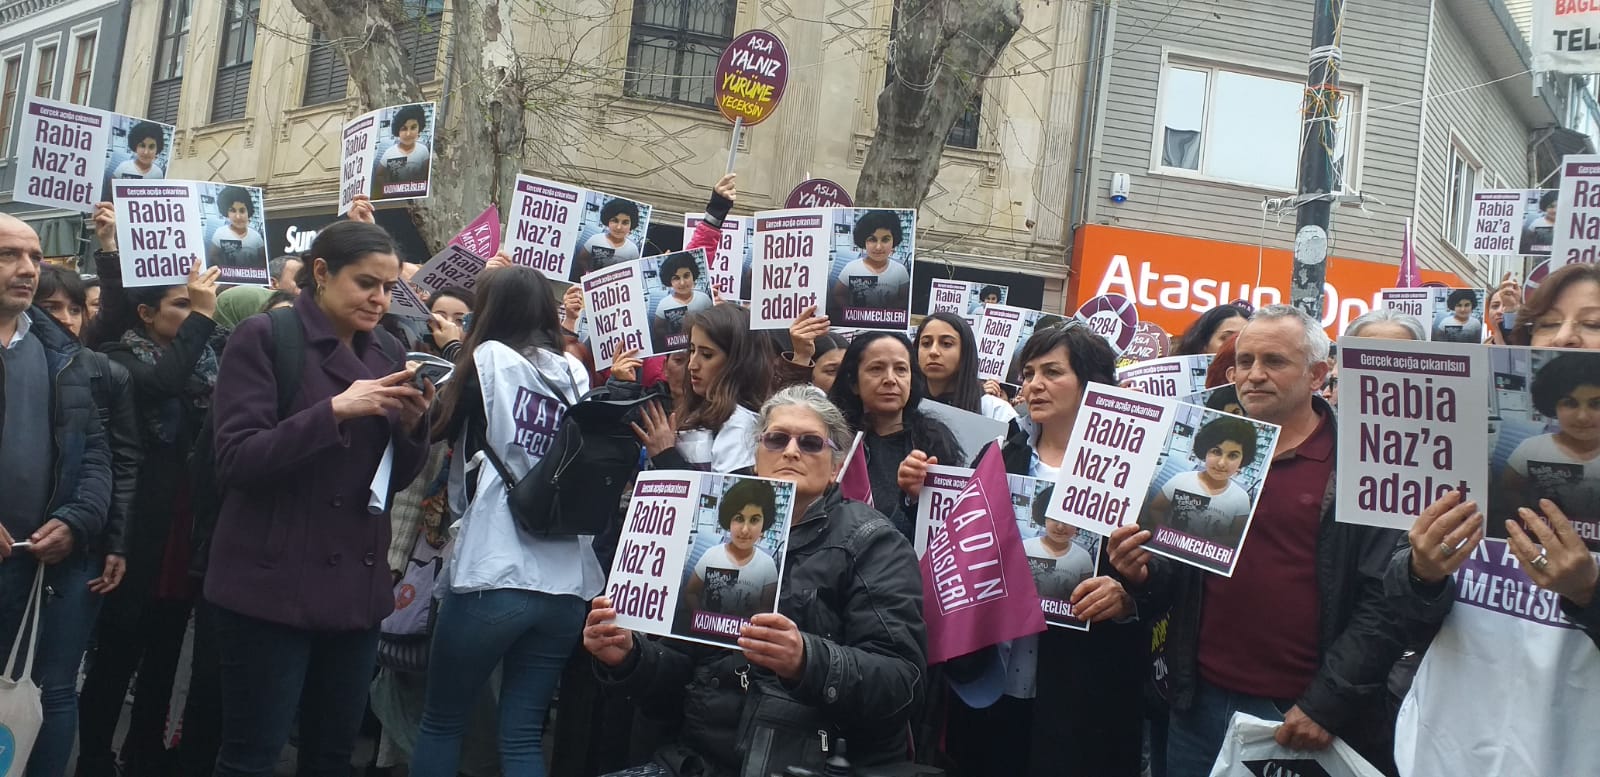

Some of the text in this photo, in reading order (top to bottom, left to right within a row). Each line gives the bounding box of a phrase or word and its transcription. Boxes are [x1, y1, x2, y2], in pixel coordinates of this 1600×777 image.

[1555, 0, 1600, 16] BAGL
[747, 36, 773, 52] ASLA
[1553, 28, 1600, 52] TEL
[729, 48, 782, 78] YALNIZ
[722, 70, 776, 102] YÜRÜME
[721, 95, 763, 118] YECEKSİN
[35, 119, 92, 151] Rabia
[345, 131, 368, 160] Rabia
[31, 146, 87, 177] Naz'a
[28, 176, 94, 205] adalet
[813, 183, 838, 199] ASLA
[128, 199, 185, 223] Rabia
[521, 194, 568, 225] Rabia
[1478, 201, 1514, 217] Rabia
[131, 226, 187, 250] Naz'a
[516, 219, 561, 248] Naz'a
[1476, 219, 1511, 233] Naz'a
[763, 230, 814, 260] Rabia
[1474, 235, 1515, 250] adalet
[512, 245, 566, 274] adalet
[762, 263, 810, 290] Naz'a
[1096, 254, 1281, 314] Atasun
[591, 282, 630, 313] Rabia
[936, 289, 961, 304] Rabia
[595, 308, 632, 337] Naz'a
[984, 318, 1011, 338] Rabia
[1089, 316, 1119, 336] 6284
[979, 337, 1005, 357] Naz'a
[1360, 353, 1466, 373] Gerçek açığa çıkarılsın
[1359, 374, 1457, 423] Rabia
[1083, 411, 1146, 454] Rabia
[1359, 422, 1453, 471] Naz'a
[1072, 446, 1131, 489] Naz'a
[628, 499, 677, 537] Rabia
[1061, 485, 1130, 528] adalet
[951, 482, 1004, 601] KADIN
[1156, 527, 1234, 564] KADINMECLİSLERİ
[617, 539, 666, 577] Naz'a
[609, 580, 668, 622] adalet
